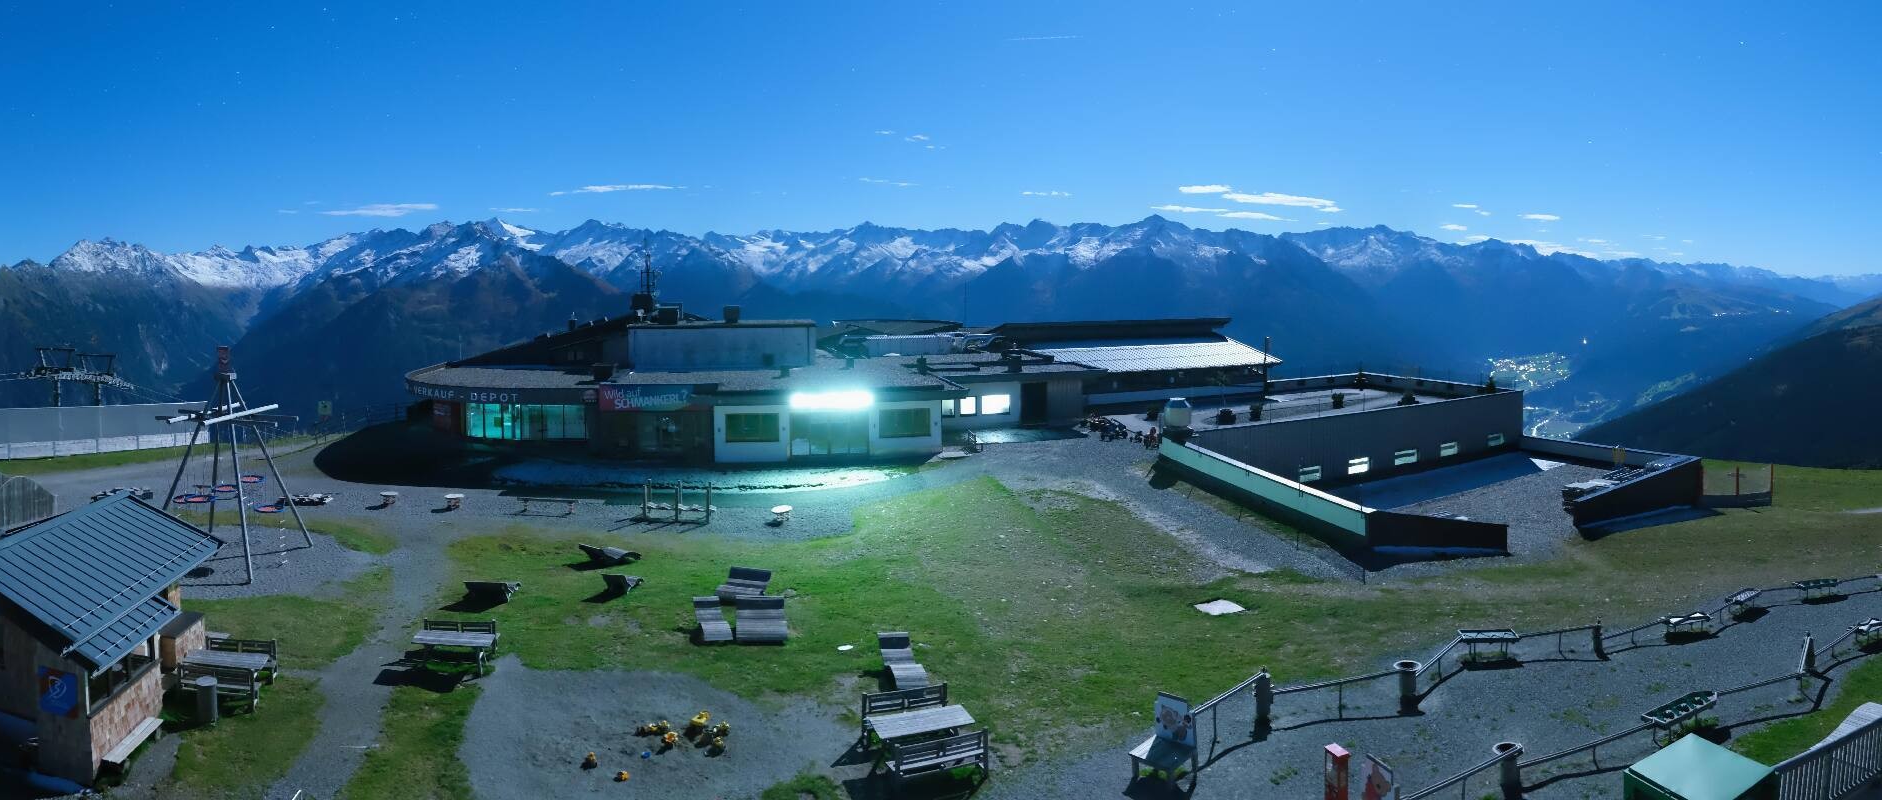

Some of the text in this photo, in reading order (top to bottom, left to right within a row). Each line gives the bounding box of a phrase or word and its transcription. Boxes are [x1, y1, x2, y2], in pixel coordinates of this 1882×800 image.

[413, 385, 455, 399] VERKAUF
[470, 392, 519, 402] DEPOT
[603, 387, 642, 400] Wild auf
[614, 389, 688, 409] SCHMANKERL?
